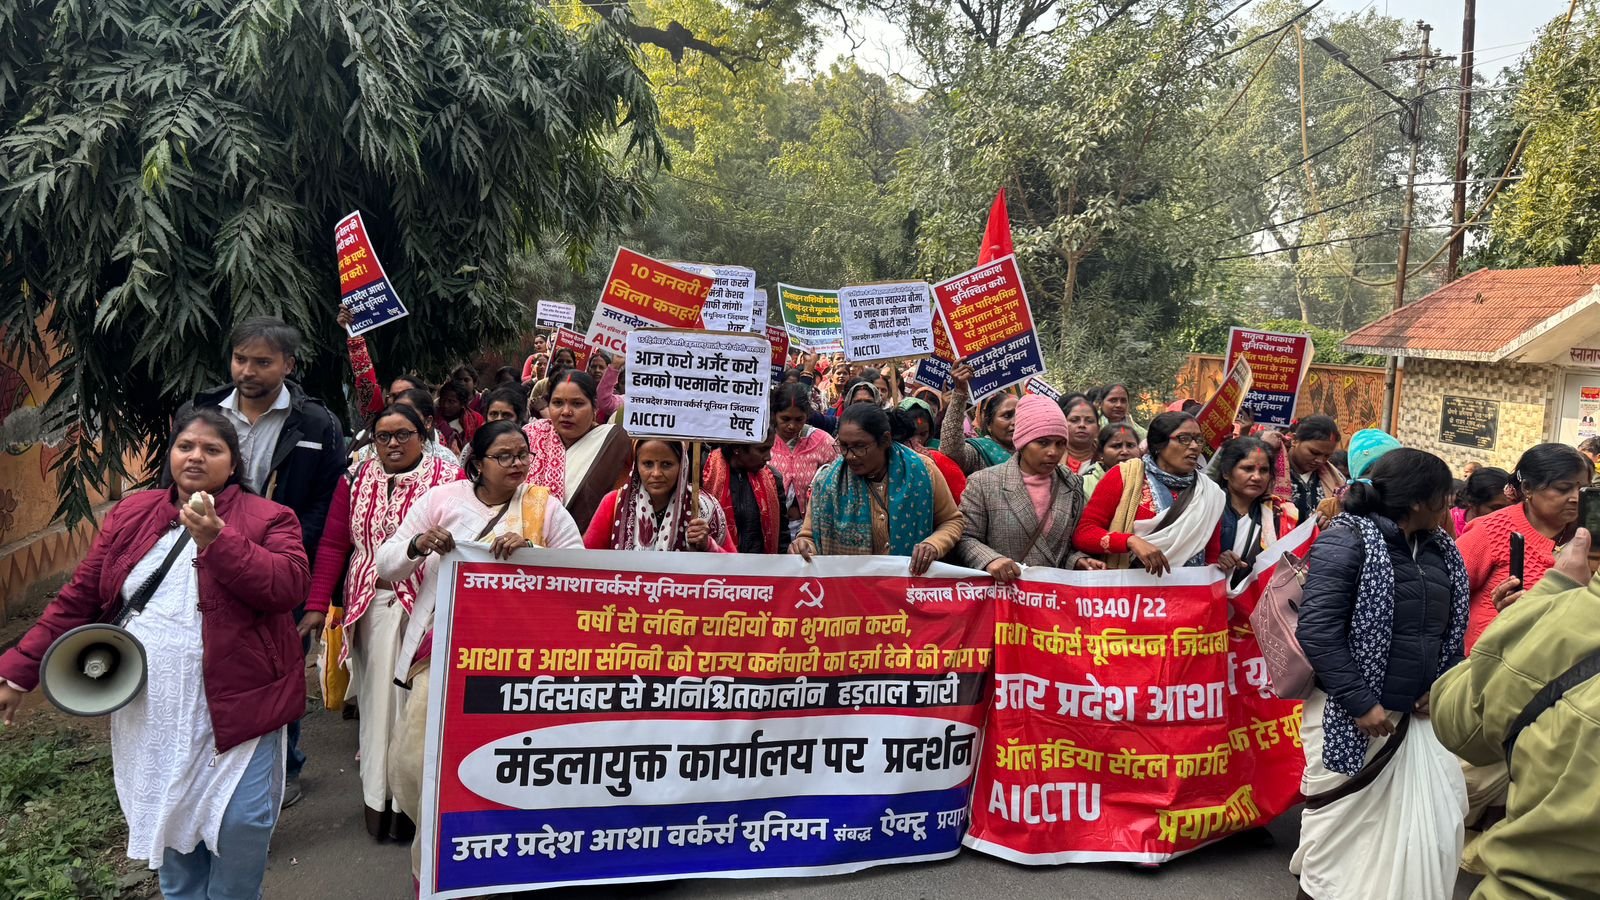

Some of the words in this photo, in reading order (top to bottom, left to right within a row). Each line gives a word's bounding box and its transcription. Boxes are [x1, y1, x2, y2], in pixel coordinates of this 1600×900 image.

[367, 281, 386, 295] आशा
[630, 263, 650, 279] 10
[651, 269, 701, 296] जनवरी
[730, 278, 749, 288] करने
[944, 278, 970, 292] मातृत्व
[970, 264, 1002, 283] अवकाश
[364, 294, 388, 311] यूनियन
[608, 278, 653, 307] जिला
[652, 297, 701, 321] कचहरी
[725, 288, 744, 299] केशव
[849, 299, 858, 307] 10
[858, 297, 875, 306] लाख
[876, 296, 884, 305] का
[885, 295, 907, 304] स्वास्थ्य
[949, 304, 975, 320] अर्जित
[975, 287, 1017, 309] पारिश्रमिक
[950, 283, 988, 306] सुनिश्चित
[602, 307, 622, 321] उत्तर
[853, 311, 863, 319] 50
[863, 309, 879, 318] लाख
[880, 308, 889, 317] का
[890, 305, 907, 316] जीवन
[907, 304, 923, 313] बीमा
[953, 321, 964, 330] के
[964, 310, 993, 329] भुगतान
[993, 305, 1002, 315] के
[1003, 299, 1019, 311] नाम
[352, 318, 374, 331] AICCTU
[806, 328, 820, 336] आशा
[868, 319, 878, 330] की
[878, 317, 895, 329] गारंटी
[896, 316, 911, 327] करो!
[963, 329, 976, 339] पर
[977, 313, 1009, 335] आशाओं
[1009, 311, 1017, 321] से
[912, 336, 929, 351] ऐक्टू
[964, 334, 989, 352] वसूली
[989, 330, 1005, 341] बन्द
[1241, 331, 1264, 342] मातृत्व
[1265, 334, 1296, 344] अवकाश
[1241, 340, 1275, 351] सुनिश्चित
[853, 344, 880, 357] AICCTU
[966, 354, 984, 367] उत्तर
[985, 345, 1006, 360] प्रदेश
[1007, 335, 1030, 352] आशा
[1257, 353, 1298, 365] पारिश्रमिक
[1570, 347, 1600, 362] स्नाना
[635, 351, 663, 366] आज
[666, 350, 694, 369] करो
[696, 352, 730, 372] अर्जेंट
[731, 356, 759, 374] करो
[925, 364, 945, 378] वर्कर्स
[973, 360, 997, 378] वर्कर्स
[997, 349, 1028, 371] यूनियन
[1269, 363, 1278, 371] के
[1279, 365, 1295, 373] नाम
[631, 370, 672, 389] हमको
[674, 374, 730, 393] परमानेंट
[732, 378, 763, 396] करो!
[917, 375, 940, 389] AICCTU
[1255, 381, 1270, 389] बन्द
[1279, 373, 1288, 382] से
[973, 380, 998, 398] AICCTU
[1267, 394, 1291, 403] आशा
[630, 396, 645, 404] उत्तर
[645, 395, 662, 406] प्रदेश
[663, 398, 683, 407] आशा
[683, 398, 704, 409] वर्कर्स
[704, 401, 728, 412] यूनियन
[729, 401, 760, 415] जिंदाबाद
[1253, 401, 1284, 411] यूनियन
[630, 412, 676, 428] AICCTU
[729, 413, 755, 437] ऐक्टू
[463, 572, 499, 590] उत्तर
[501, 568, 544, 592] प्रदेश
[546, 574, 595, 593] आशा
[595, 574, 642, 597] वर्कर्स
[643, 577, 703, 603] यूनियन
[703, 578, 773, 602] जिंदाबाद!
[906, 584, 953, 605] इंकलाब
[956, 582, 996, 602] जिंदाब
[1075, 593, 1167, 623] 10340/22
[576, 604, 617, 633] वर्षों
[617, 607, 639, 633] से
[641, 608, 699, 636] लंबित
[701, 610, 772, 637] राशियों
[772, 616, 798, 638] का
[801, 615, 861, 644] भुगतान
[865, 609, 912, 638] करने,
[1031, 625, 1082, 656] वर्कर्स
[1086, 627, 1168, 666] यूनियन
[1170, 626, 1229, 656] जिंदाबा
[457, 647, 513, 671] आशा
[517, 648, 534, 671] व
[538, 648, 593, 671] आशा
[596, 643, 664, 672] संगिनी
[667, 645, 694, 673] को
[697, 652, 745, 673] राज्य
[748, 645, 820, 673] कर्मचारी
[823, 650, 848, 672] का
[848, 643, 884, 674] दर्ज़ा
[884, 642, 914, 670] देने
[915, 643, 941, 670] की
[942, 645, 975, 670] मांग
[500, 675, 616, 712] 15दिसंबर
[618, 674, 646, 709] से
[650, 675, 829, 710] अनिश्चितकालीन
[838, 680, 910, 711] हड़ताल
[914, 671, 960, 705] जारी
[995, 672, 1049, 712] उत्तर
[1055, 673, 1138, 722] प्रदेश
[1147, 681, 1225, 722] आशा
[995, 737, 1036, 772] ऑल
[1039, 739, 1102, 772] इंडिया
[1108, 747, 1169, 780] सेंट्रल
[1228, 727, 1250, 752] फ
[1250, 717, 1280, 750] ट्रेड
[494, 736, 672, 797] मंडलायुक्त
[677, 730, 817, 780] कार्यालय
[822, 737, 868, 774] पर
[882, 724, 976, 774] प्रदर्शन
[988, 779, 1101, 825] AICCTU
[452, 833, 512, 861] उत्तर
[516, 824, 585, 859] प्रदेश
[589, 826, 663, 851] आशा
[667, 814, 738, 847] वर्कर्स
[741, 810, 829, 852] यूनियन
[833, 824, 873, 842] संबद्ध
[880, 808, 929, 841] ऐक्टू
